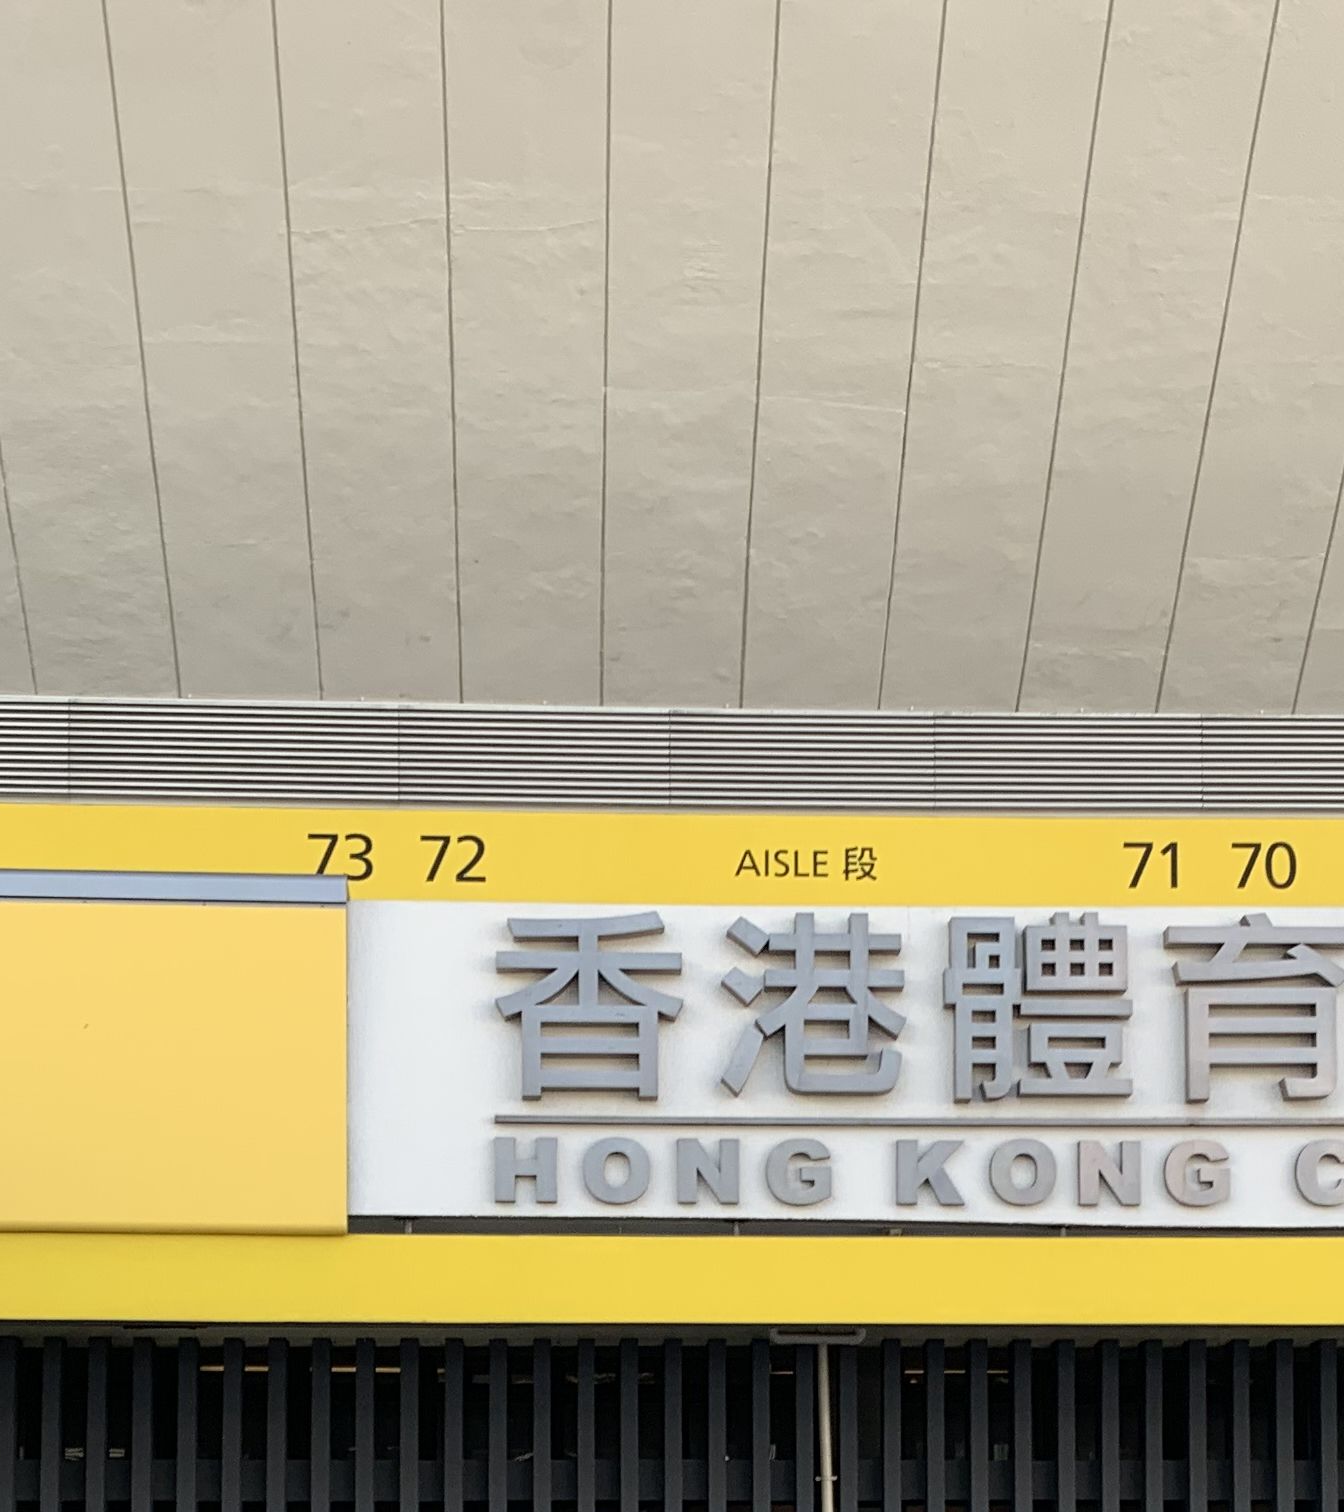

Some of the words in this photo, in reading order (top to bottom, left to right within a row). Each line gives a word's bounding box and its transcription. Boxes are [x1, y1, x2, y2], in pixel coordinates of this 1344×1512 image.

[307, 833, 373, 881] 73
[420, 835, 487, 883] 72
[735, 848, 829, 878] AISLE
[842, 847, 878, 881] 段
[1122, 841, 1180, 888] 71
[1230, 842, 1297, 890] 70
[492, 1136, 834, 1207] HONG
[895, 1139, 1232, 1208] KONG
